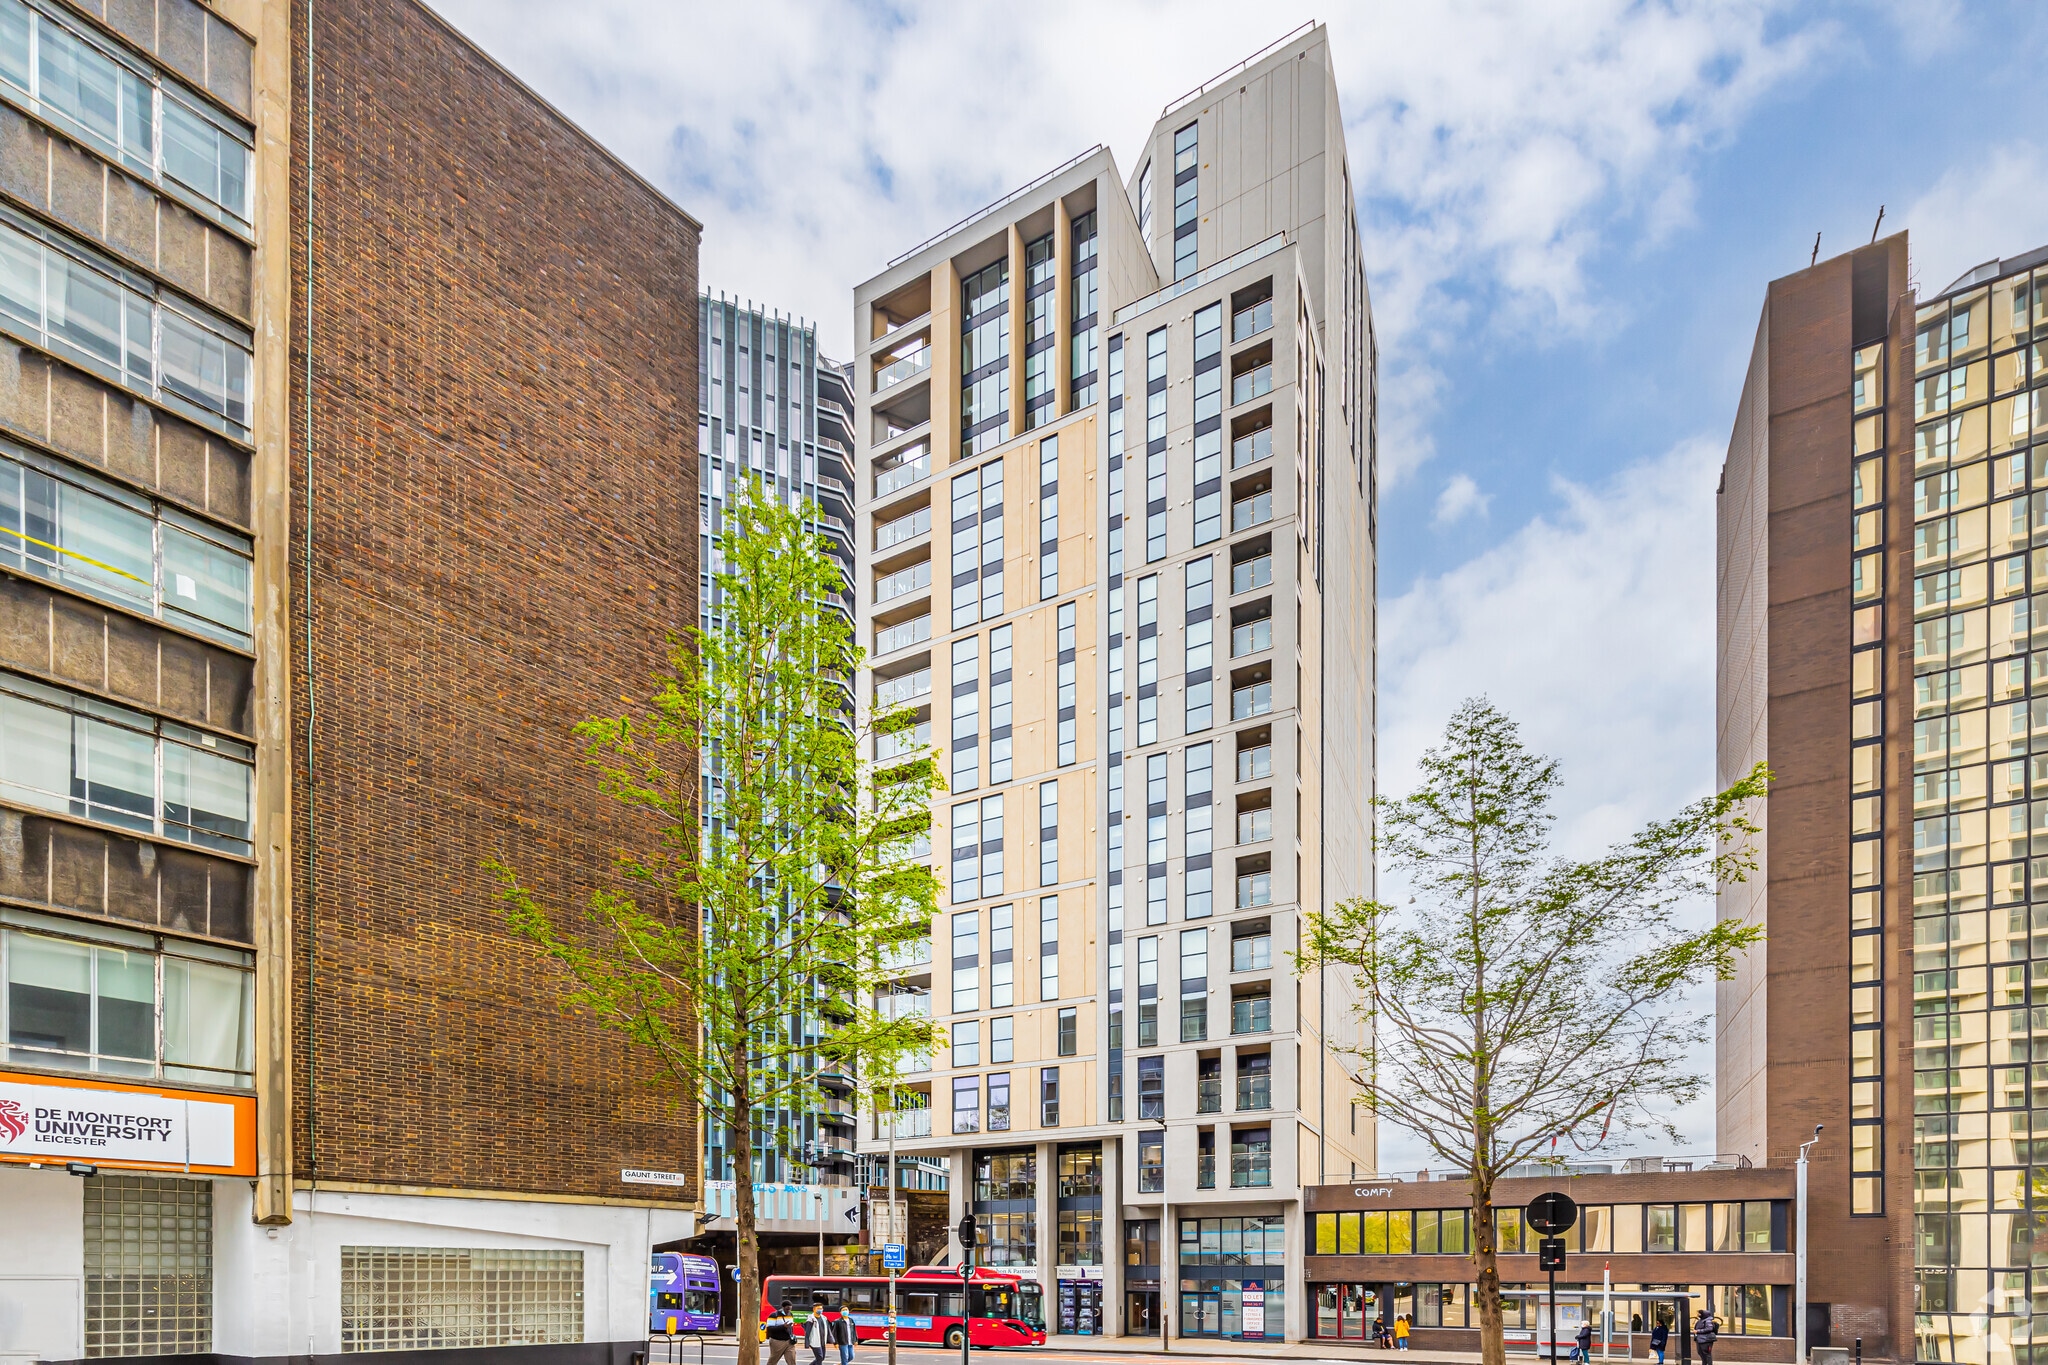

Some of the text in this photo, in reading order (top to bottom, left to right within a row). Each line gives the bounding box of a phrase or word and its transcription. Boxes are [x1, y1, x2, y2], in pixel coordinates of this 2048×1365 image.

[35, 1107, 173, 1129] DE MONTFORT
[35, 1119, 172, 1142] UNIVERSITY
[35, 1134, 107, 1147] LEICESTER
[625, 1170, 651, 1178] GAUNT
[653, 1172, 676, 1180] STREET
[1354, 1188, 1393, 1198] COMFY
